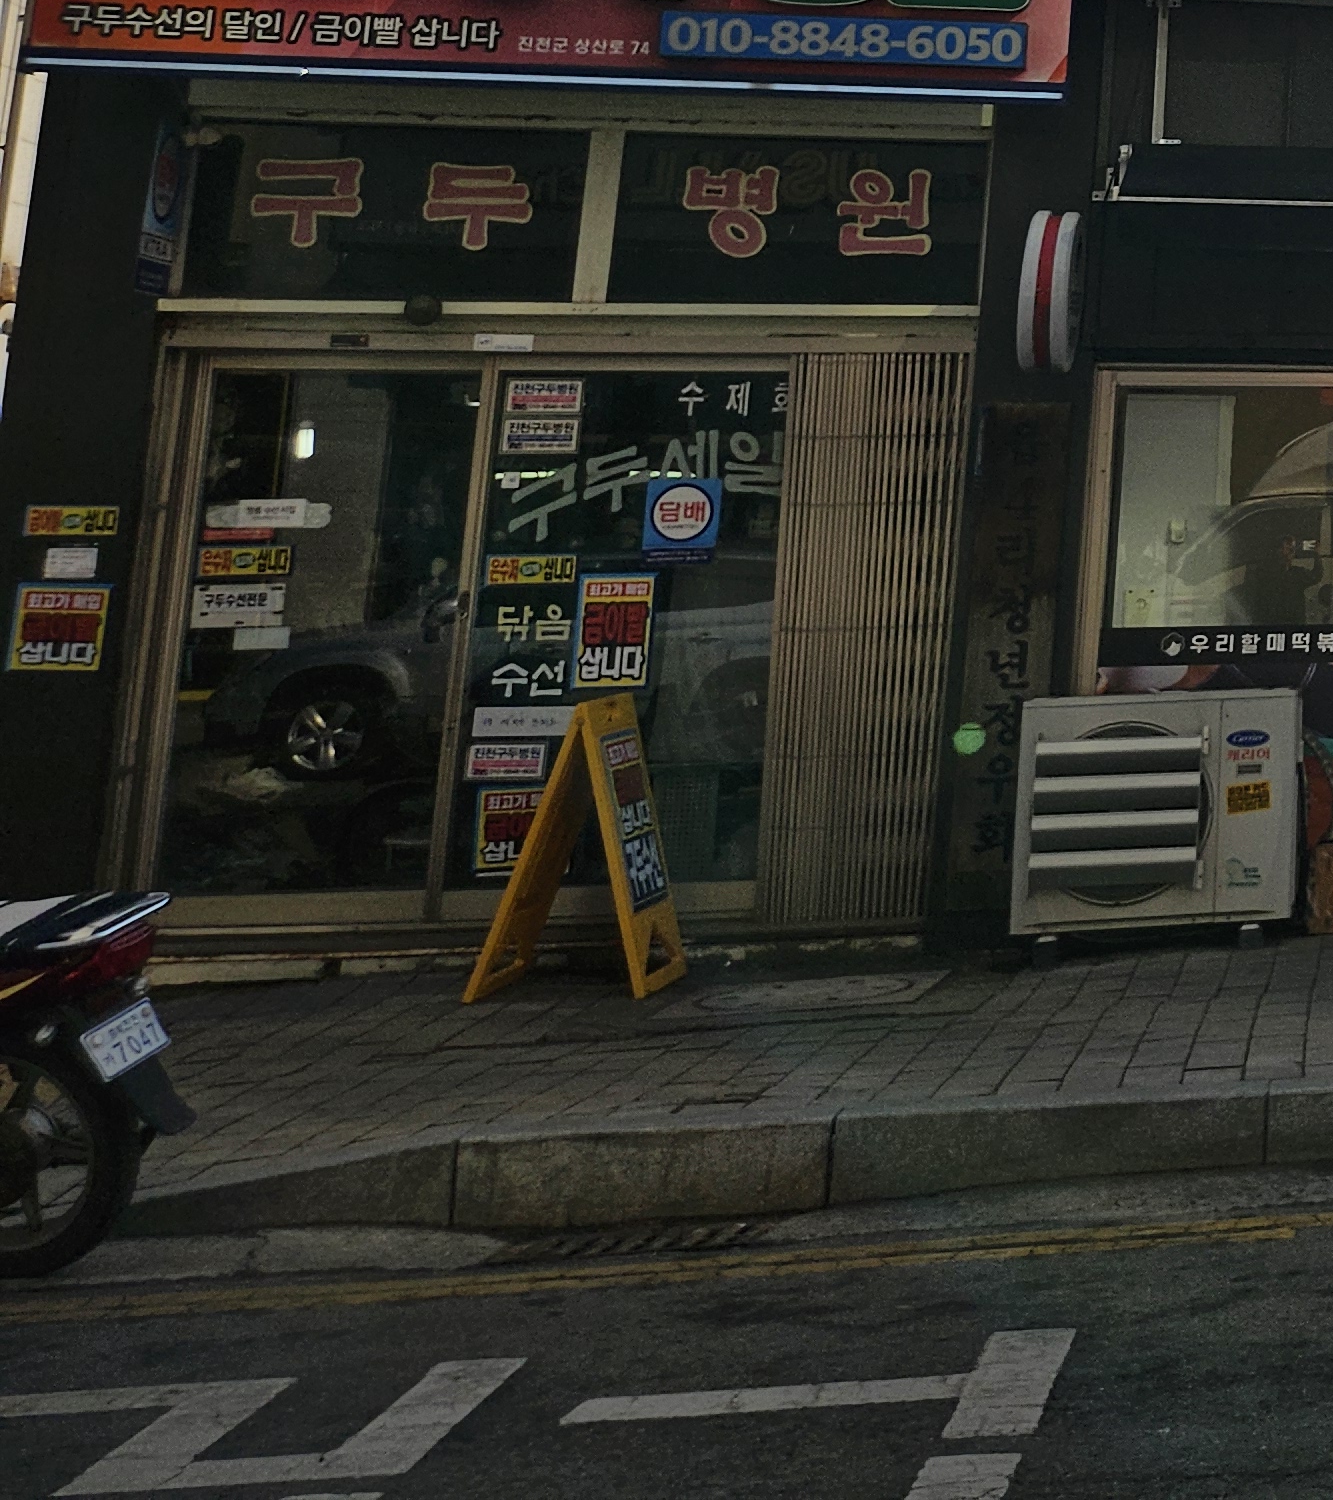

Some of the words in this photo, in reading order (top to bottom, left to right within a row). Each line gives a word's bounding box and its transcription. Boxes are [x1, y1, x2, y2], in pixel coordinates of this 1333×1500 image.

[61, 1, 215, 39] 구두수선의
[223, 9, 282, 43] 달인
[290, 11, 304, 43] /
[312, 12, 402, 48] 금이빨
[410, 16, 499, 51] 삽니다
[517, 36, 569, 57] 진천군
[573, 36, 625, 58] 상산로
[629, 40, 651, 57] 74
[667, 16, 1023, 64] 010-8848-6050
[84, 509, 116, 533] 삽니다
[660, 501, 706, 522] 담배
[258, 549, 289, 572] 삽니다
[544, 558, 575, 581] 삽니다
[498, 604, 572, 642] 닦음
[20, 641, 97, 664] 삽니다
[580, 646, 643, 680] 삽니다
[491, 660, 565, 697] 수선
[1227, 748, 1270, 761] 캐리어
